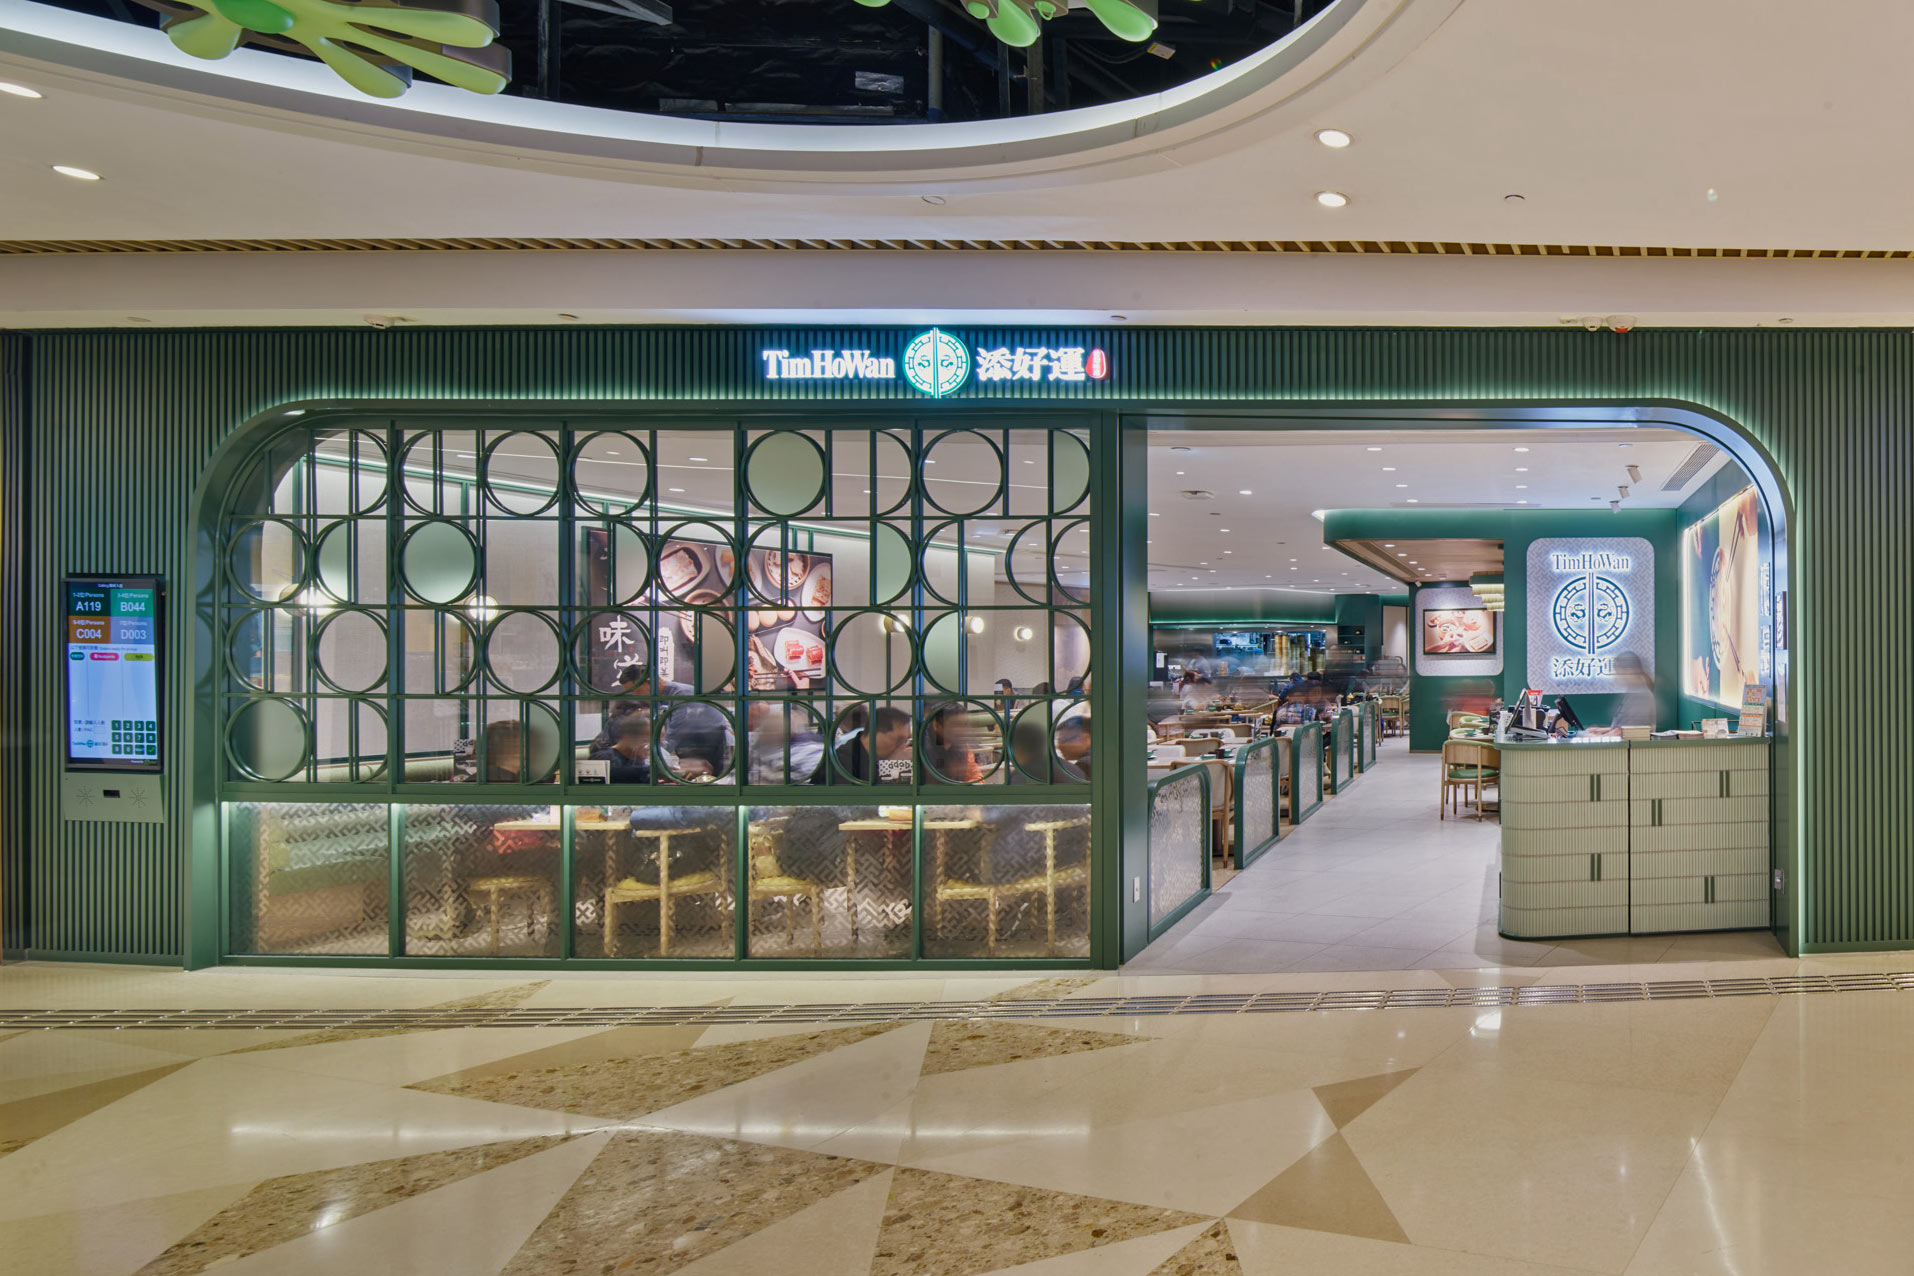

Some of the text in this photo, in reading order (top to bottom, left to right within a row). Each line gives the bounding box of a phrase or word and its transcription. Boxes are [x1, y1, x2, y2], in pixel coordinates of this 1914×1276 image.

[762, 350, 895, 380] TimHoWan
[976, 346, 1086, 382] 添好運
[1551, 552, 1630, 571] TimHoWan
[75, 601, 102, 611] A119
[120, 602, 145, 612] B044
[76, 629, 102, 639] C004
[121, 630, 147, 640] D003
